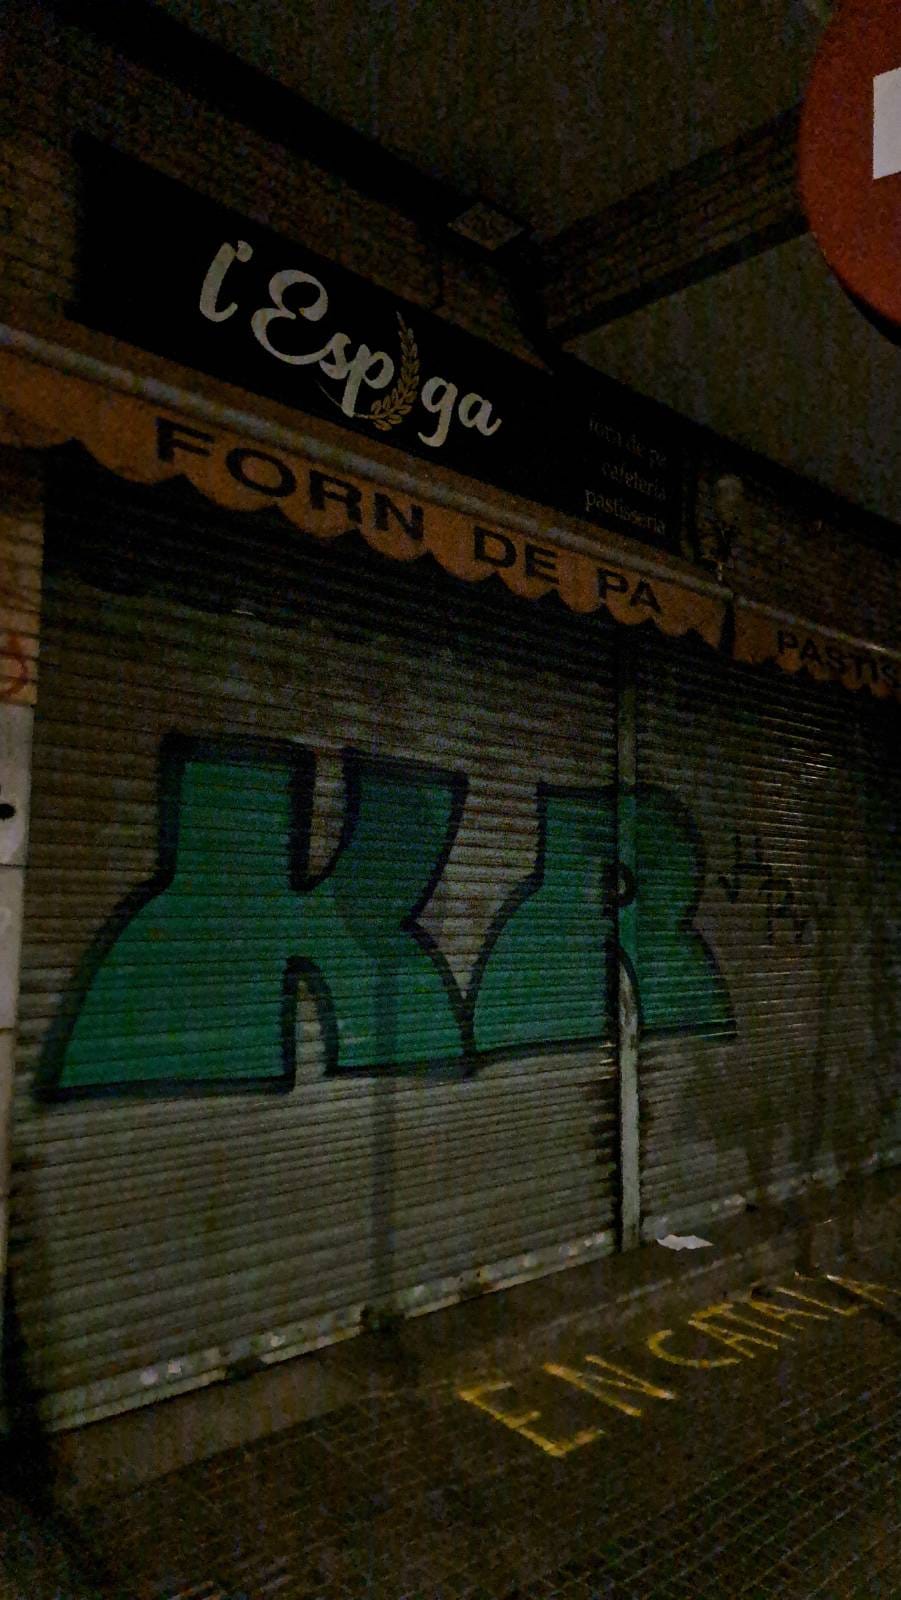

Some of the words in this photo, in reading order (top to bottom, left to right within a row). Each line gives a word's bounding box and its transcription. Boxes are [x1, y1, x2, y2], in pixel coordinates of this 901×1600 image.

[157, 417, 424, 540] FORN
[474, 526, 560, 585] DE
[598, 567, 661, 612] PA
[456, 1354, 678, 1459] EN
